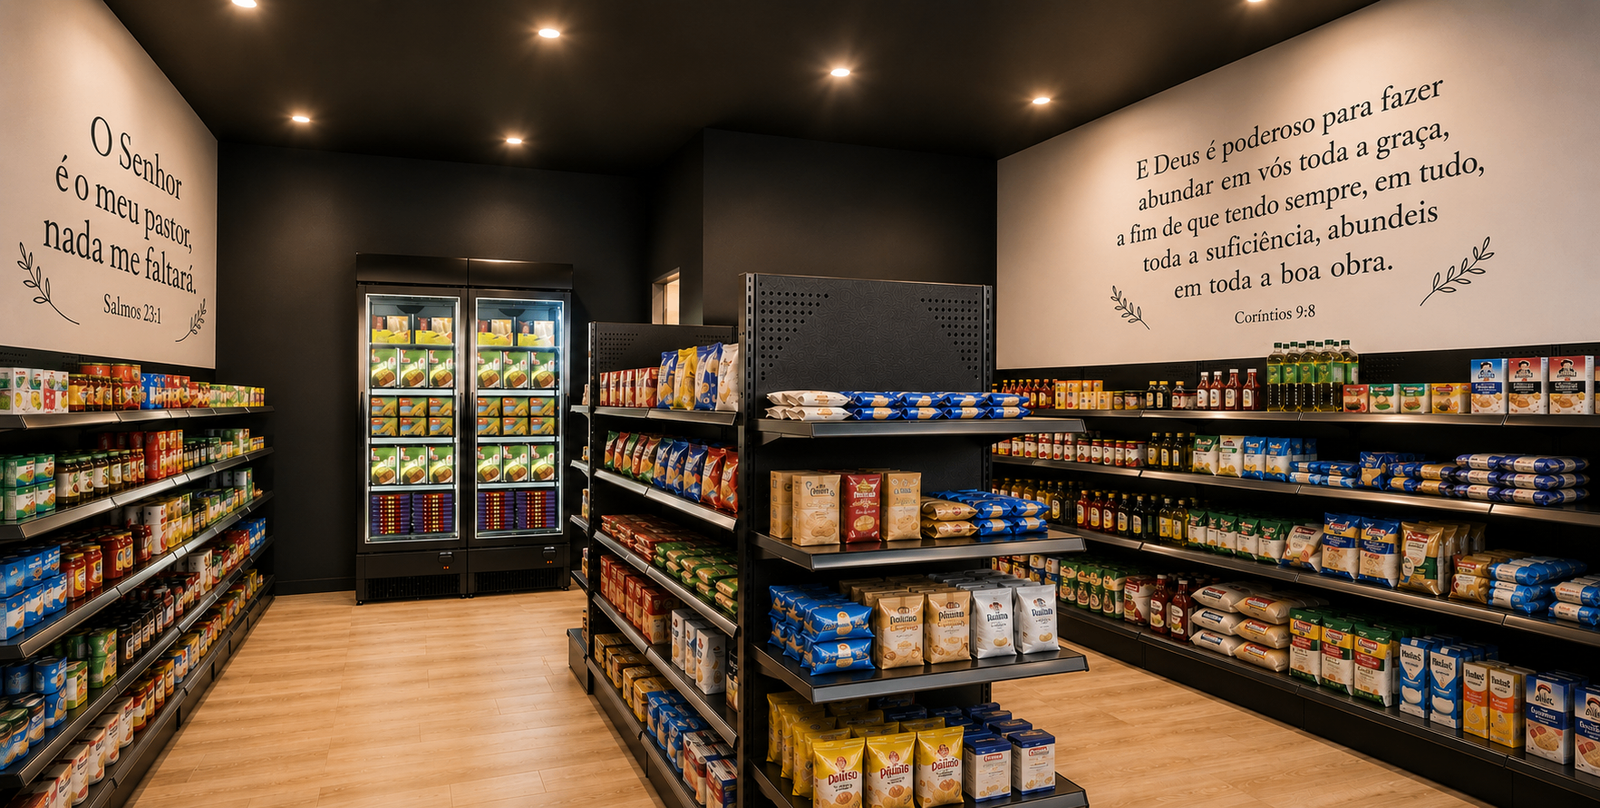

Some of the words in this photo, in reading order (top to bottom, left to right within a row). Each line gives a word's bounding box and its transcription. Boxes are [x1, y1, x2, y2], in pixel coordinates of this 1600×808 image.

[90, 116, 113, 157] O
[119, 132, 183, 200] Senhor
[1136, 158, 1149, 181] E
[1153, 150, 1200, 176] Deus
[1206, 139, 1217, 160] é
[1221, 117, 1316, 163] poderoso
[1322, 100, 1374, 136] para
[1381, 79, 1444, 113] fazer
[1138, 177, 1215, 212] abundar
[1221, 171, 1252, 191] em
[1257, 156, 1293, 182] vós
[1299, 140, 1350, 172] toda
[1356, 141, 1370, 158] a
[1375, 121, 1450, 161] graça,
[55, 154, 69, 192] é
[74, 174, 89, 201] o
[95, 183, 140, 224] meu
[144, 207, 193, 255] pastor,
[1116, 233, 1126, 247] a
[1130, 223, 1158, 244] fim
[1162, 215, 1183, 237] de
[1187, 212, 1220, 238] que
[1224, 194, 1280, 224] tendo
[1285, 181, 1368, 211] sempre,
[1374, 171, 1412, 193] em
[1419, 150, 1486, 183] tudo,
[1143, 247, 1182, 273] toda
[1188, 250, 1199, 265] a
[1206, 224, 1321, 263] suficiência,
[1327, 200, 1439, 241] abundeis
[43, 218, 104, 264] nada
[110, 243, 140, 276] me
[145, 246, 198, 295] faltará.
[1173, 282, 1203, 299] em
[1208, 268, 1252, 294] toda
[1260, 272, 1272, 288] a
[1280, 261, 1322, 285] boa
[1330, 251, 1394, 278] obra.
[103, 293, 142, 321] Salmos
[143, 303, 162, 325] 23:1
[1234, 309, 1293, 325] Coríntios
[1295, 303, 1317, 319] 9:8
